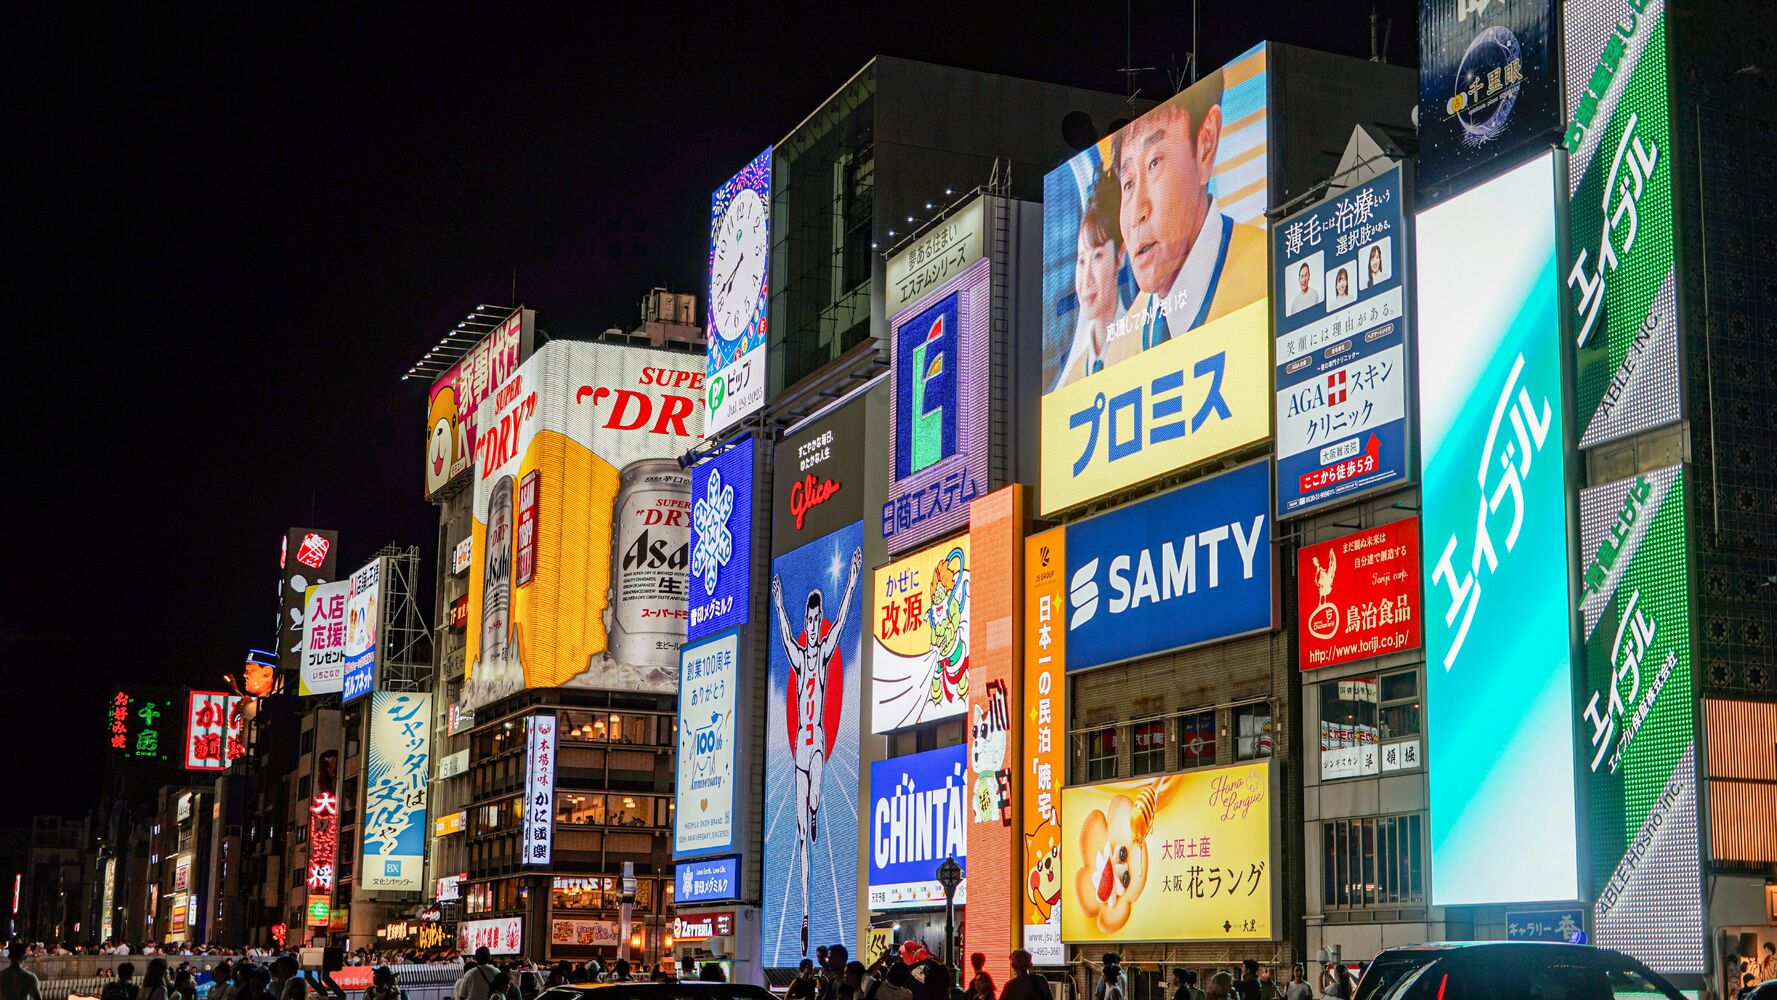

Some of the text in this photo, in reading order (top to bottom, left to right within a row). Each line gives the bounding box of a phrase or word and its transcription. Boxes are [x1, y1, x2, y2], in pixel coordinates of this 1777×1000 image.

[1468, 58, 1523, 103] 千里眼
[736, 201, 745, 221] 12
[753, 216, 761, 234] 2
[1285, 187, 1391, 259] 薄毛には治療という
[1568, 112, 1658, 348] エイブル
[908, 224, 958, 272] 夢ある住まい
[900, 243, 967, 304] エステムシリーズ
[1287, 302, 1395, 356] 笑顔には理由がある。
[639, 366, 706, 391] SUPE
[727, 359, 752, 398] ピップ
[1599, 310, 1662, 420] ABLE INC.
[494, 374, 522, 416] SUPER
[1287, 359, 1394, 419] AGA スキン
[576, 385, 706, 439] “DR
[1069, 350, 1233, 479] プロミス
[1306, 400, 1373, 446] クリニック
[1304, 455, 1375, 489] ここから徒歩5分
[655, 498, 691, 509] SUPER
[882, 466, 977, 539] 日商エステム
[1432, 352, 1552, 673] エイブル
[658, 576, 683, 595] 生
[886, 567, 919, 598] かぜに
[1107, 514, 1265, 615] SAMTY
[312, 594, 345, 622] 入店
[881, 591, 923, 640] 改源
[1345, 593, 1411, 634] 鳥治食品
[310, 620, 347, 651] 応援
[1309, 629, 1410, 664] http://www.toriji.co.jp/
[687, 649, 732, 682] 創業100周年
[1038, 594, 1052, 754] 日本一の民泊
[1584, 588, 1655, 773] エイブル
[691, 680, 725, 706] ありがとう
[805, 672, 817, 747] グリコ
[1608, 650, 1679, 776] エイブル保証株式会社
[135, 702, 161, 751] 千房
[533, 738, 550, 860] 本場の味 かに道楽
[386, 862, 400, 874] BX
[1162, 835, 1211, 861] 大阪土産
[1599, 780, 1686, 919] ABLE Hosho Inc.
[1162, 860, 1266, 900] 大阪 花ラング
[681, 921, 714, 938] ZETTERIA
[1508, 922, 1552, 937] ギャラリー
